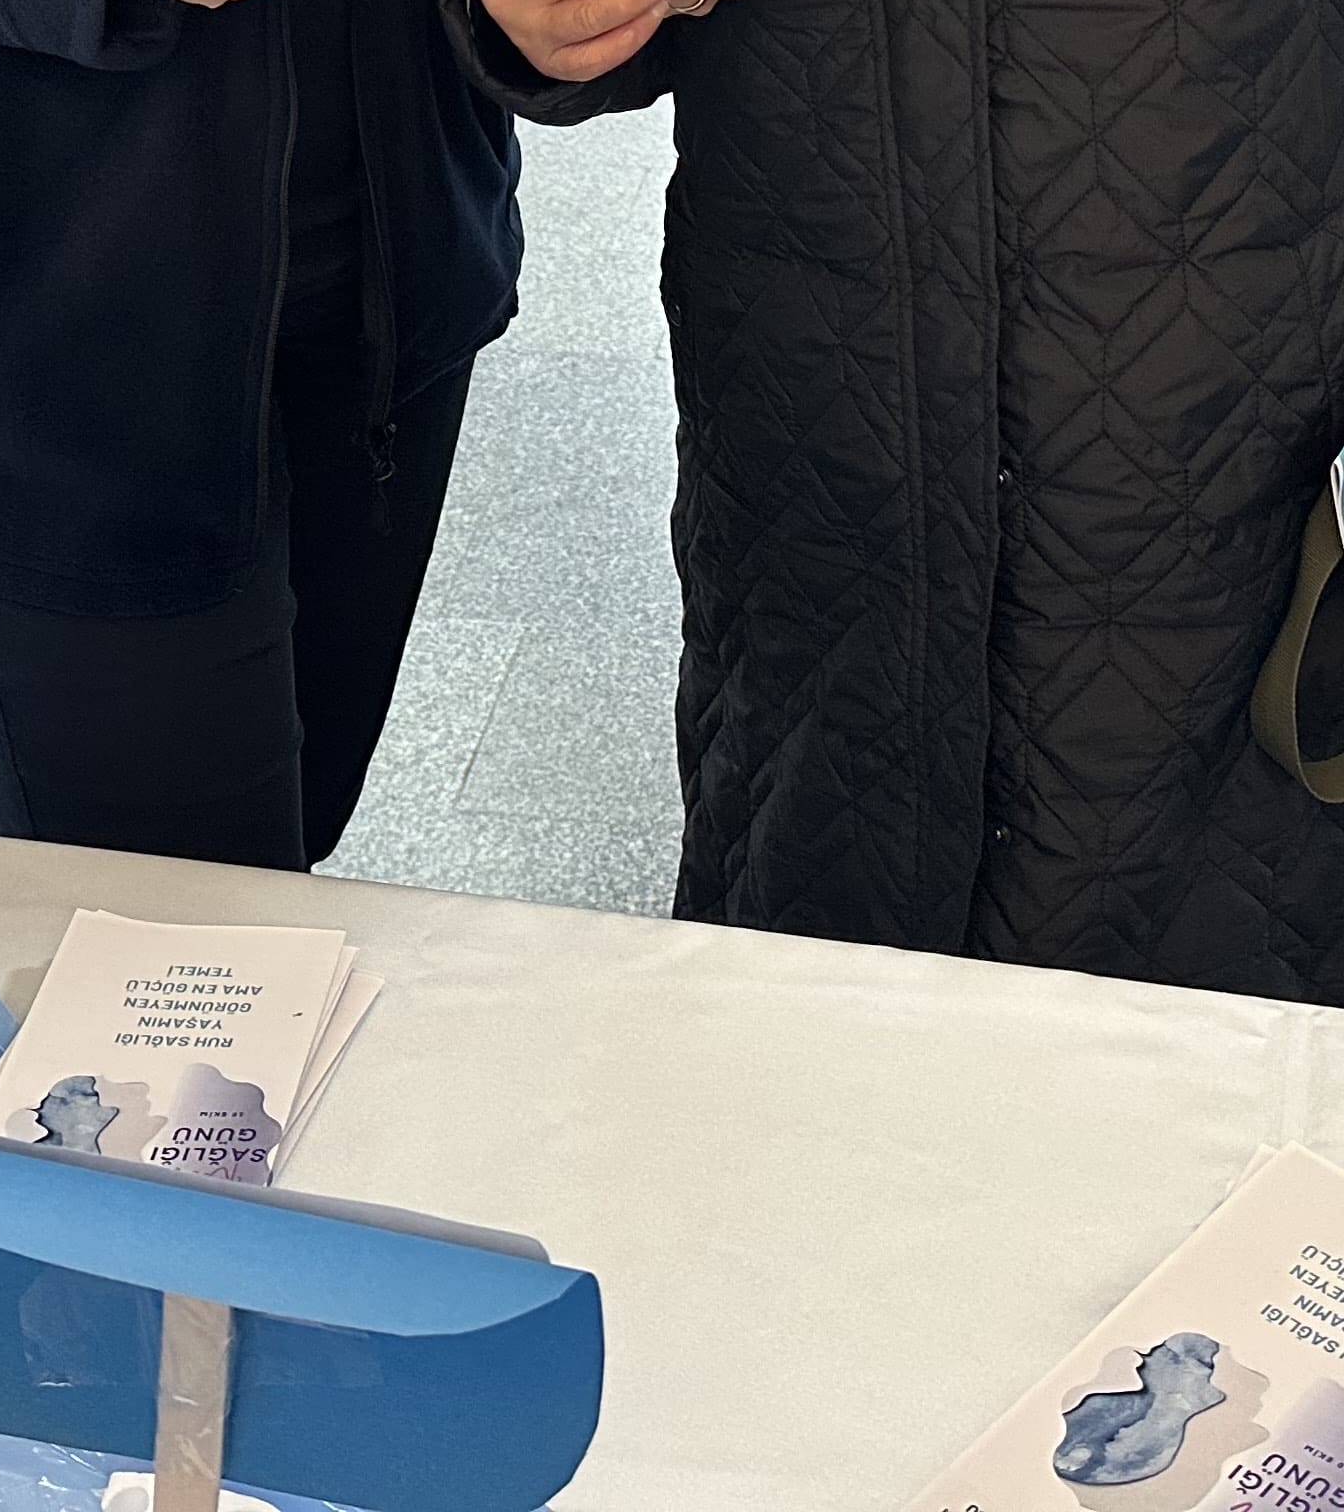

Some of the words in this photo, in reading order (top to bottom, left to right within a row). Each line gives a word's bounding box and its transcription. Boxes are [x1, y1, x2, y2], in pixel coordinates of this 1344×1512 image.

[166, 965, 233, 978] TEMELİ
[125, 979, 188, 995] GÜÇLÜ
[191, 983, 218, 995] EN
[224, 985, 264, 996] AMA
[123, 997, 252, 1015] GÖRÜNMEYEN
[137, 1016, 223, 1030] YAŞAMIN
[115, 1033, 191, 1048] SAĞLIĞI
[194, 1036, 234, 1048] RUH
[172, 1127, 257, 1145] GÜNÜ
[150, 1146, 267, 1166] SAĞLIĞI
[1260, 1303, 1340, 1354] SAĞLIĞI
